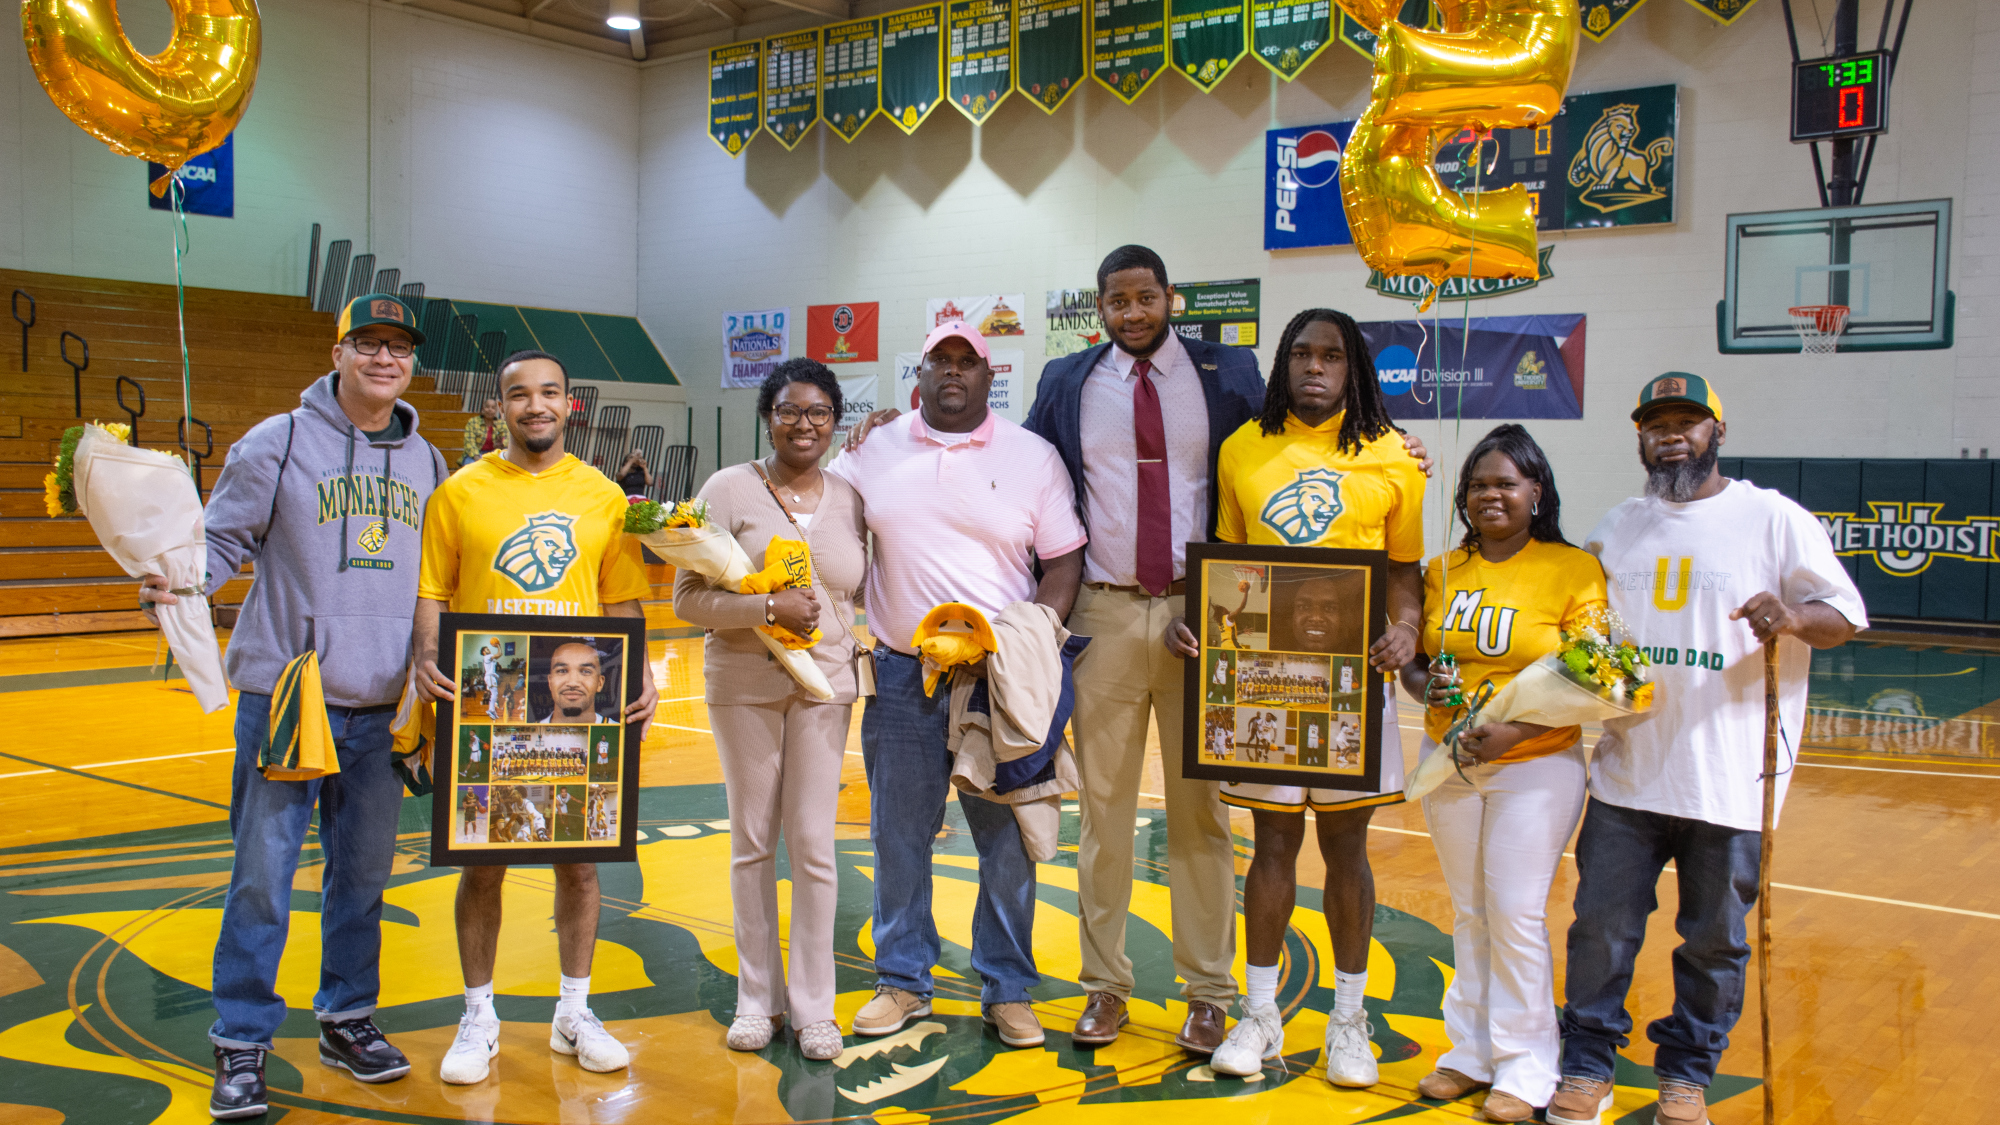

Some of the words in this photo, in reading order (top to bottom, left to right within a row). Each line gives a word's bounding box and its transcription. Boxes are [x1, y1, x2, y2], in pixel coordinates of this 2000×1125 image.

[952, 3, 1010, 20] BASKETBALL
[1020, 7, 1036, 16] NCAA
[1171, 12, 1202, 24] NATIONAL
[1204, 5, 1242, 18] CHAMPIONS
[1254, 2, 1274, 12] NCAA
[888, 9, 935, 26] BASEBALL
[908, 18, 936, 28] CHAMPS
[977, 14, 1005, 24] CHAMPS
[1138, 20, 1162, 32] CHAMPS
[830, 22, 874, 37] BASEBALL
[772, 34, 813, 47] BASEBALL
[716, 45, 755, 58] BASEBALL
[1095, 52, 1114, 61] NCAA
[1116, 44, 1163, 58] APPEARANCES
[1819, 59, 1873, 88] 7:33
[1838, 86, 1864, 128] 0
[715, 116, 730, 124] NCAA
[174, 164, 216, 183] NCAA
[1434, 161, 1460, 173] RIOD
[1276, 136, 1298, 232] PEPSI
[1523, 181, 1546, 190] OULS
[1063, 291, 1098, 310] CARDI
[1197, 292, 1230, 300] Exceptional
[1050, 311, 1104, 330] LANDSCA
[732, 336, 778, 352] NATIONALS
[1378, 369, 1417, 382] NCAA
[1422, 368, 1470, 382] Division
[1474, 368, 1484, 381] III
[988, 390, 1008, 398] RSITY
[844, 398, 874, 413] bee's
[322, 466, 364, 478] METHOIST
[370, 466, 412, 484] UNIRSITY
[317, 474, 420, 532] MONARCHS
[1820, 518, 1998, 556] METHODIST
[1616, 571, 1731, 591] METHODIST
[1652, 556, 1694, 613] U
[487, 598, 578, 616] BASKETBALL
[1437, 588, 1520, 657] MU
[1638, 646, 1678, 665] OUD
[1685, 648, 1724, 671] DAD
